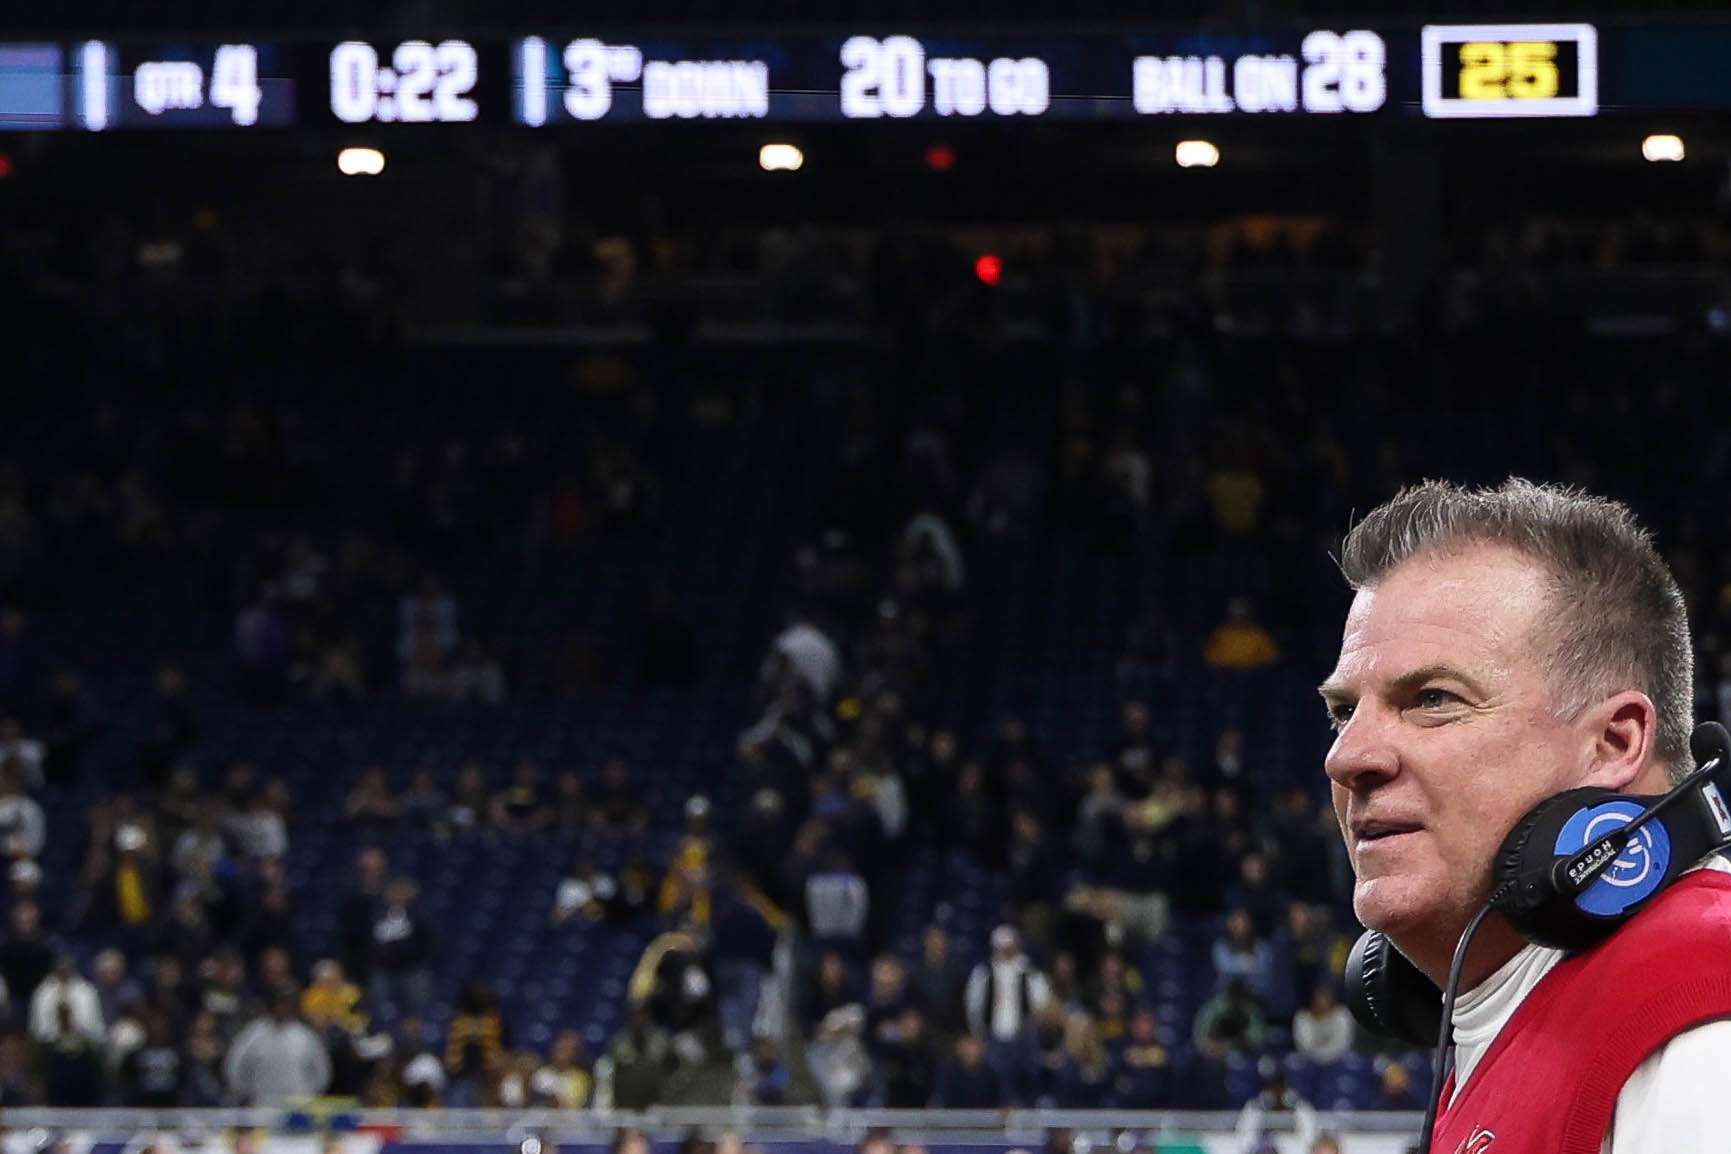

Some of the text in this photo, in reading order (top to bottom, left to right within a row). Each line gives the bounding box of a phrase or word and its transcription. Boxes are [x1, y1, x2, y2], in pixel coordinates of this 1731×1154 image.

[209, 44, 262, 126] 4
[330, 41, 478, 123] 0:22
[643, 60, 768, 119] DOWN
[840, 35, 1049, 118] 20 TO GO
[1133, 29, 1386, 114] BALL ON 28
[1459, 42, 1559, 99] 25
